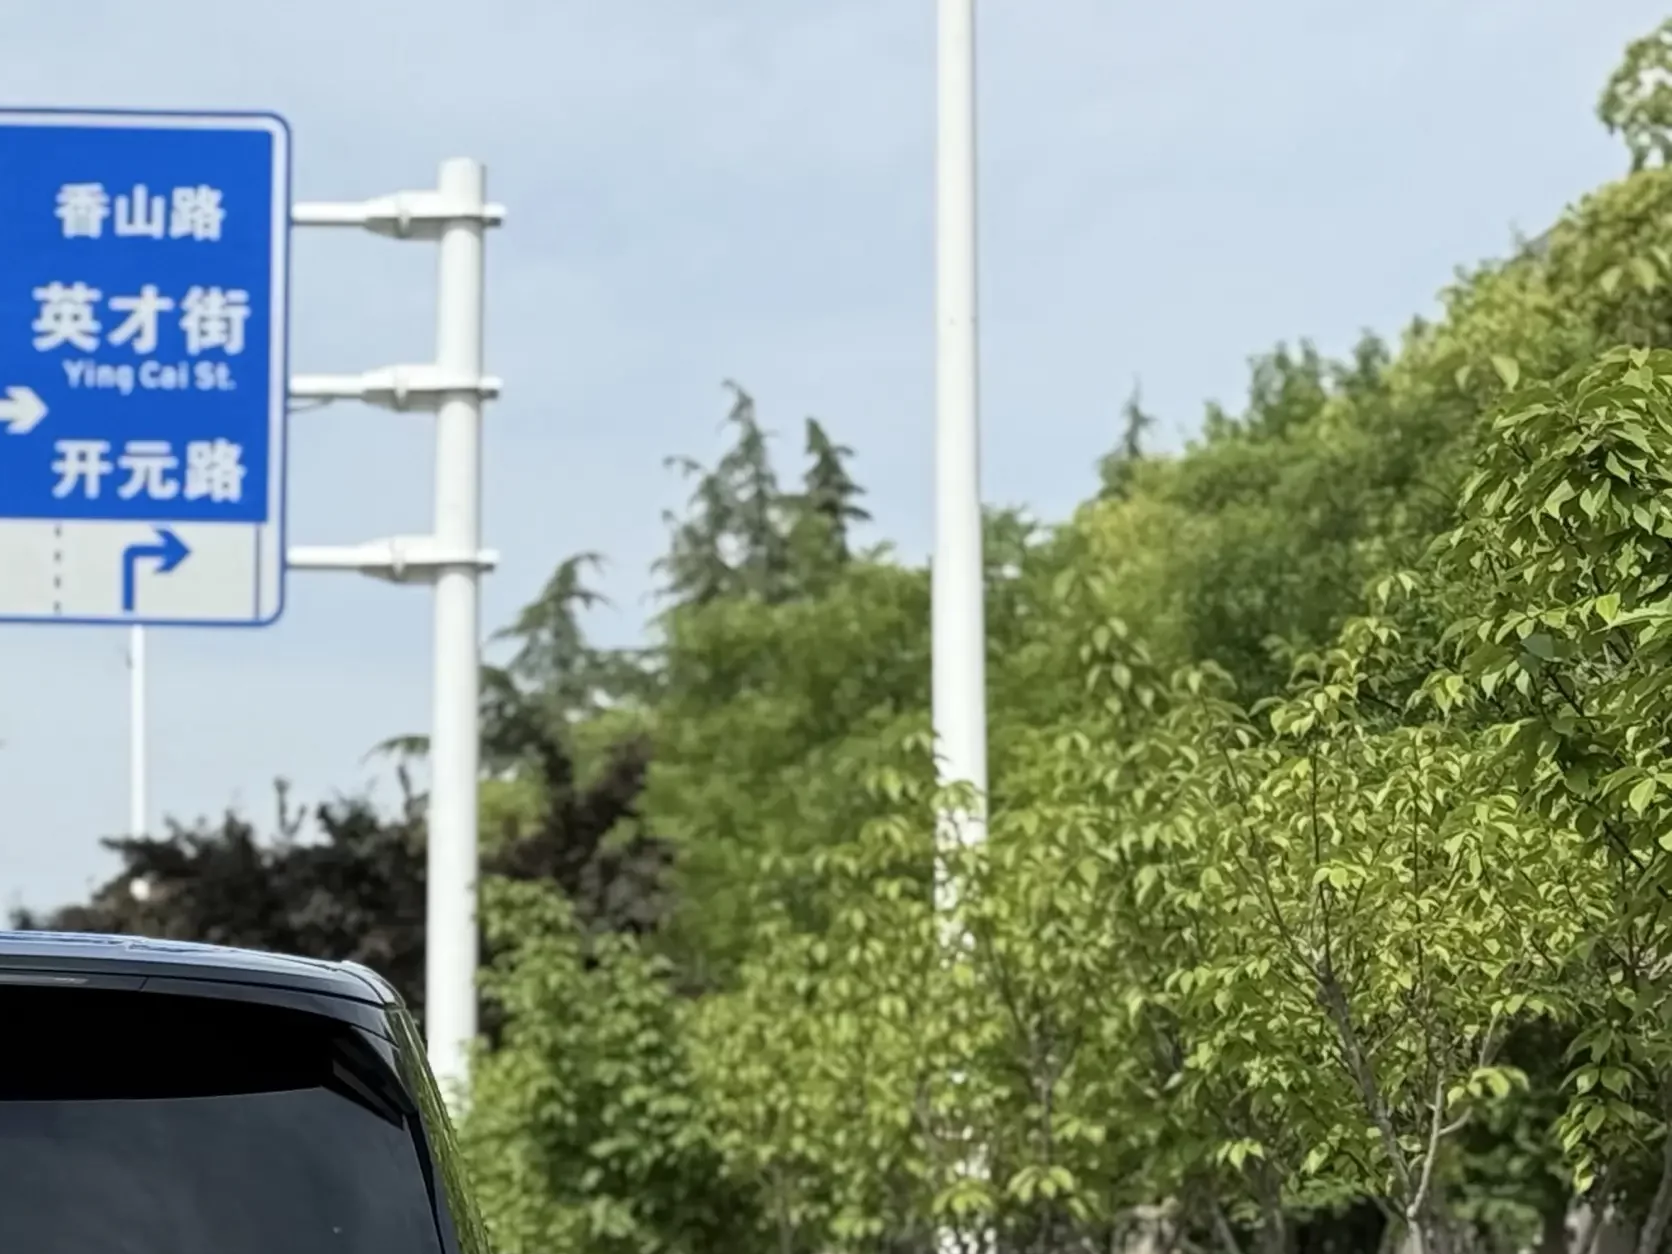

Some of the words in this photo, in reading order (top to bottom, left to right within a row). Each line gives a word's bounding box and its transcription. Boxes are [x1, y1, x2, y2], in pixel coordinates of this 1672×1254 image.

[54, 182, 226, 242] 香山路
[31, 281, 251, 355] 英才街
[62, 358, 134, 395] Ying
[139, 360, 189, 390] Cai
[194, 360, 237, 391] St.
[51, 437, 247, 503] 开元路
